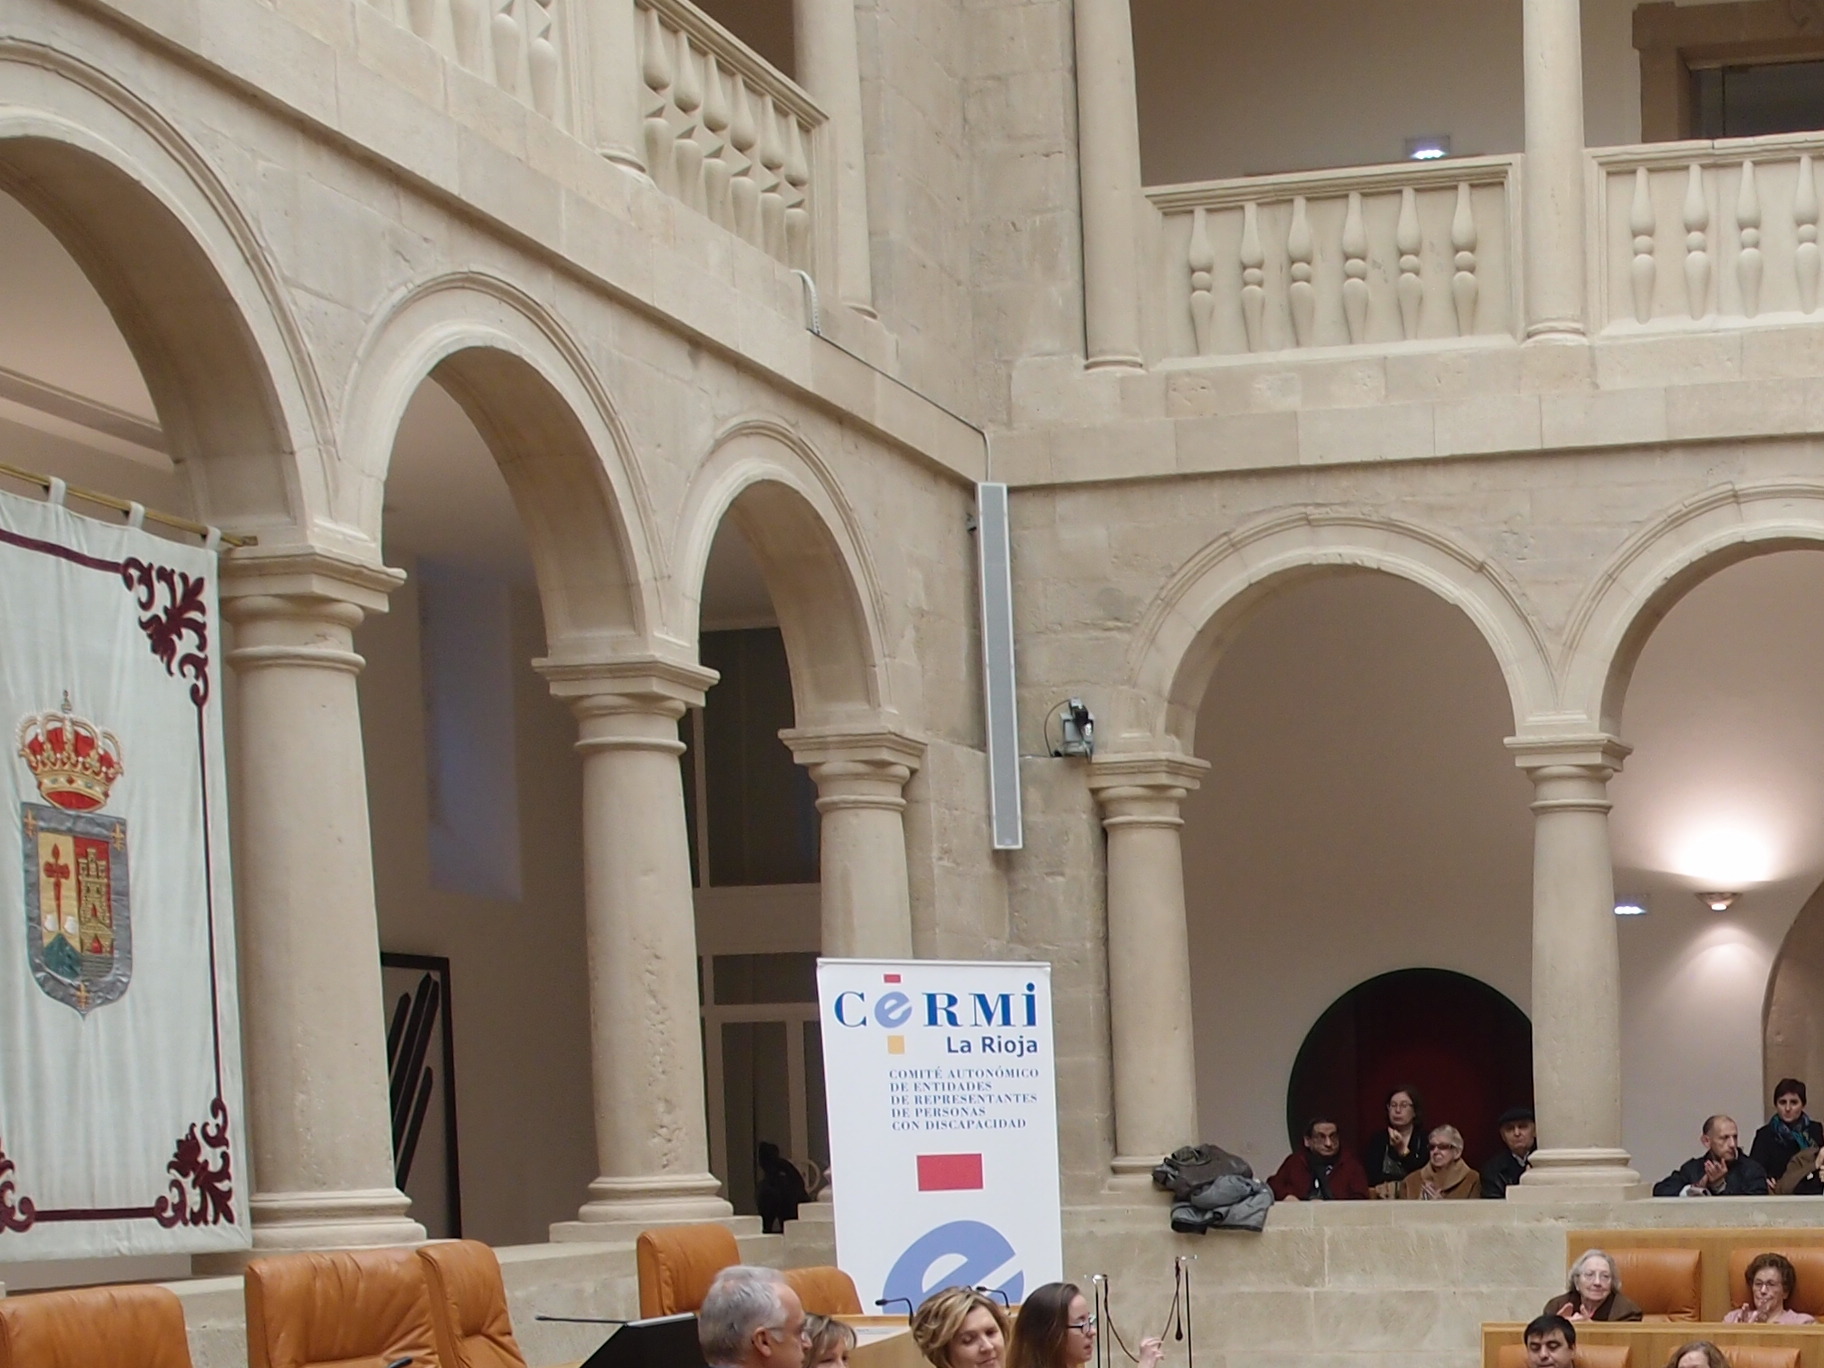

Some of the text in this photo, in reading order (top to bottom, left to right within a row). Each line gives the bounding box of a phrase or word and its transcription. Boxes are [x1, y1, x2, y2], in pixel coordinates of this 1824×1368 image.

[947, 1035, 1038, 1058] La Rioja
[889, 1065, 1039, 1079] COMITÉ AUTONÓMICO
[890, 1081, 992, 1092] DE ENTIDADES
[891, 1094, 1038, 1105] DE REPRESENTANTES
[891, 1107, 986, 1118] DE PERSONAS
[892, 1119, 1027, 1131] CON DISCAPACIDAD
